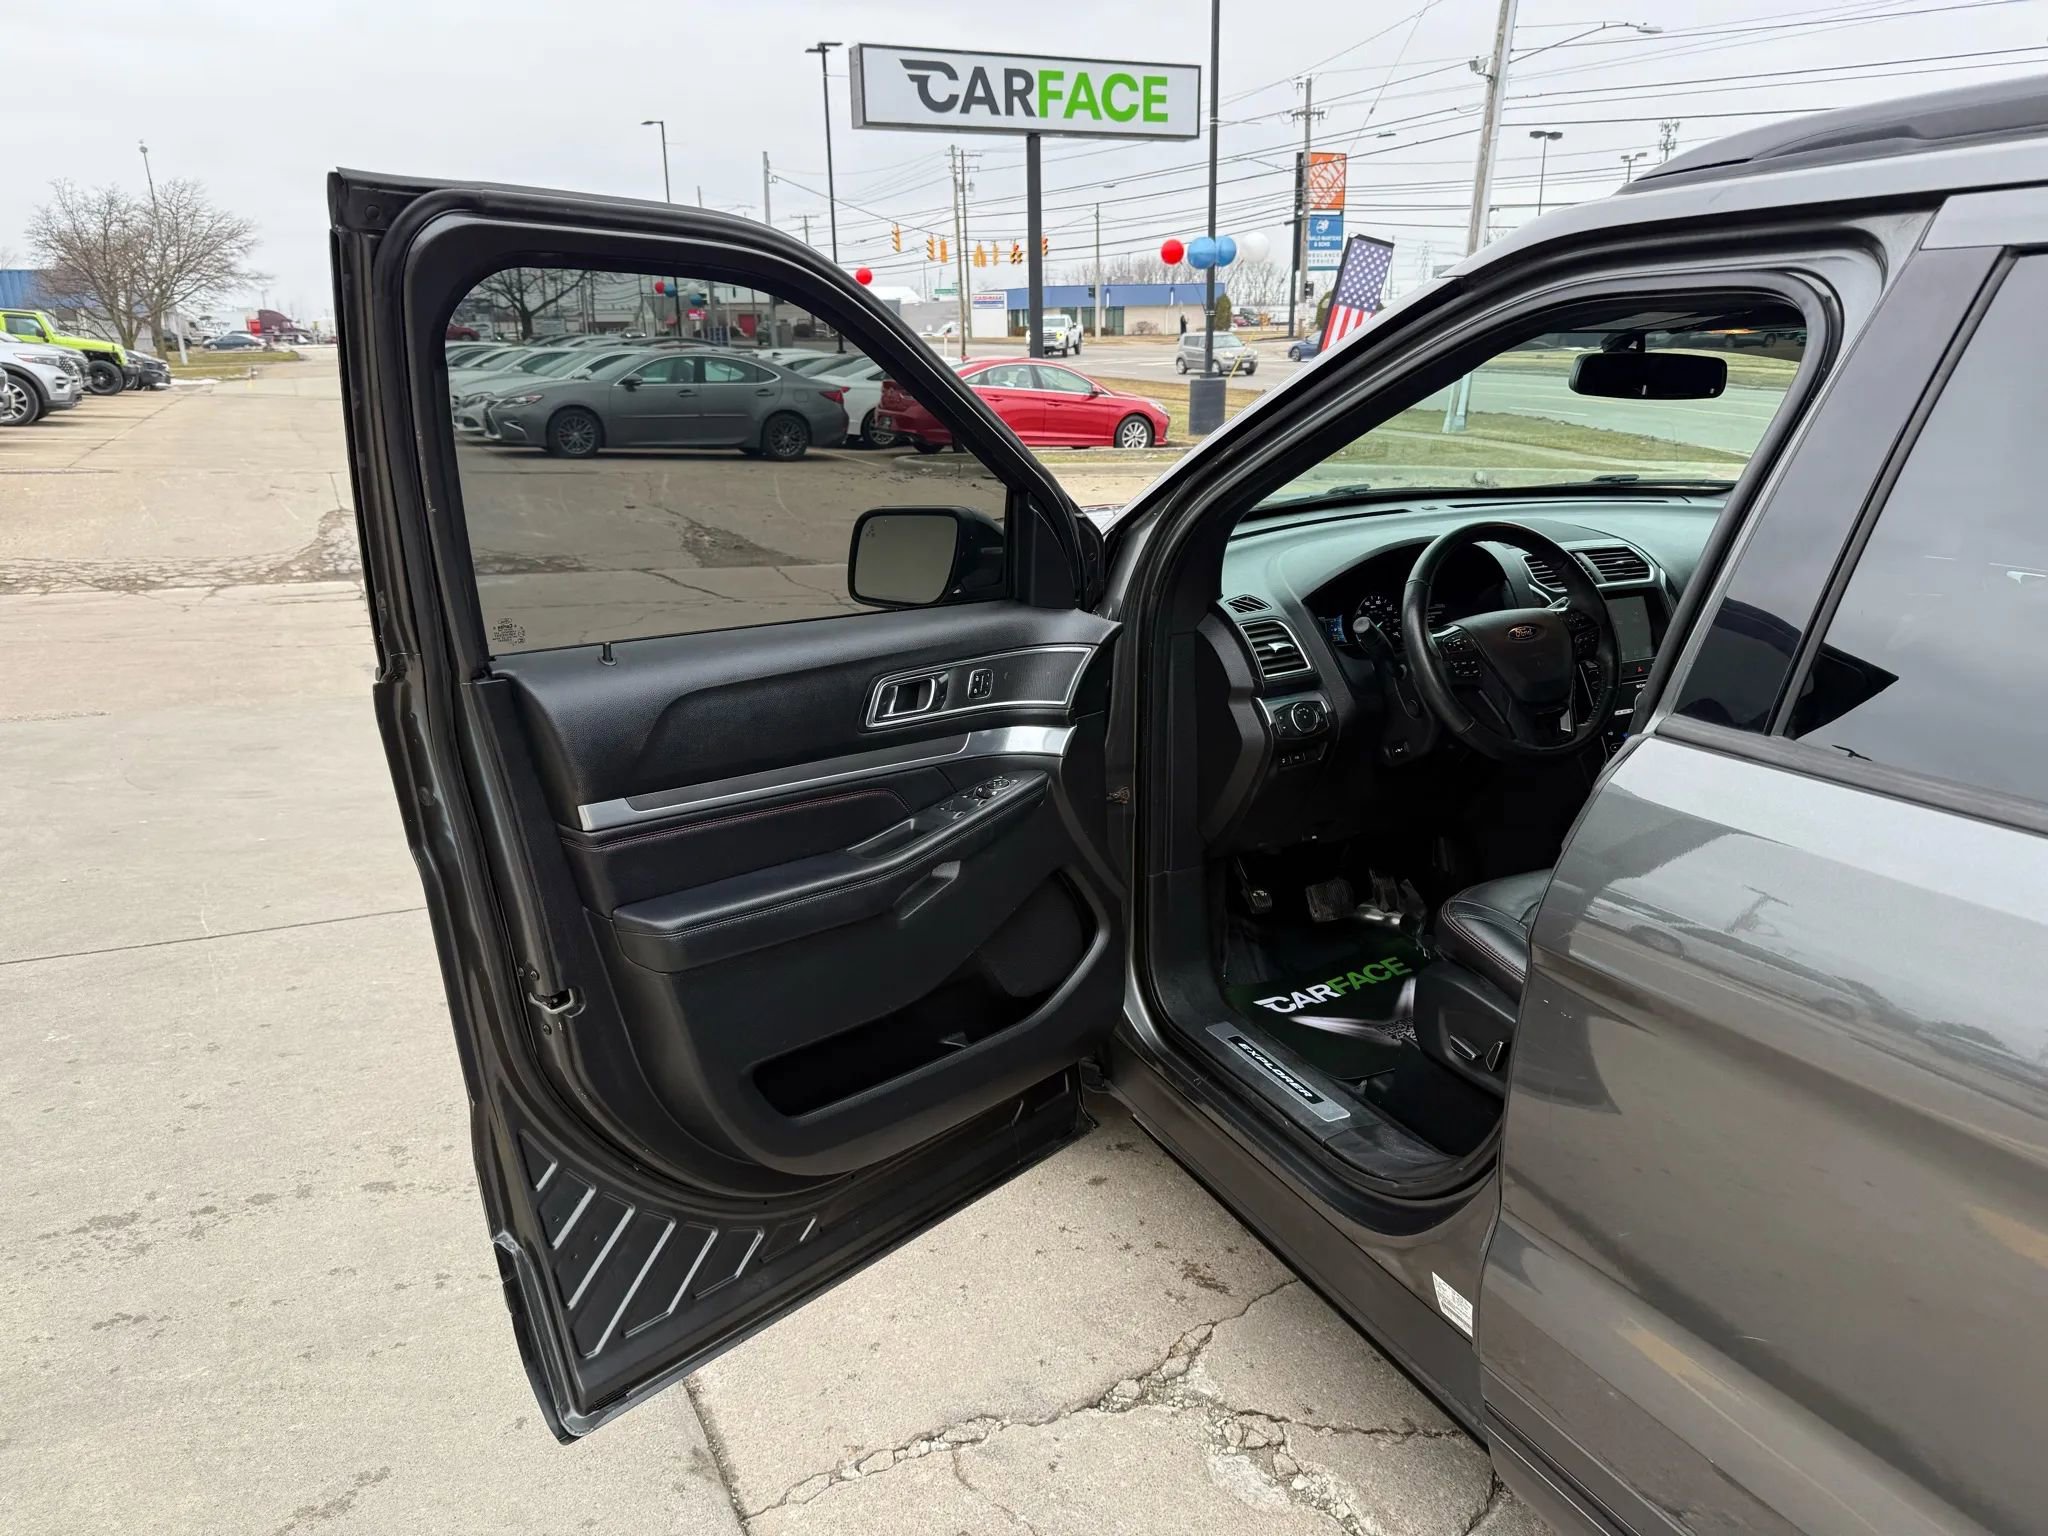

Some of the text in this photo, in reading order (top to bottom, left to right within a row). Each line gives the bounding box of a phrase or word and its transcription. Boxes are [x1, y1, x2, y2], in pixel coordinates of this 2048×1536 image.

[899, 58, 1169, 123] CARFACE
[1253, 956, 1413, 1014] CARFACE
[1237, 1041, 1314, 1099] EXPLORER
